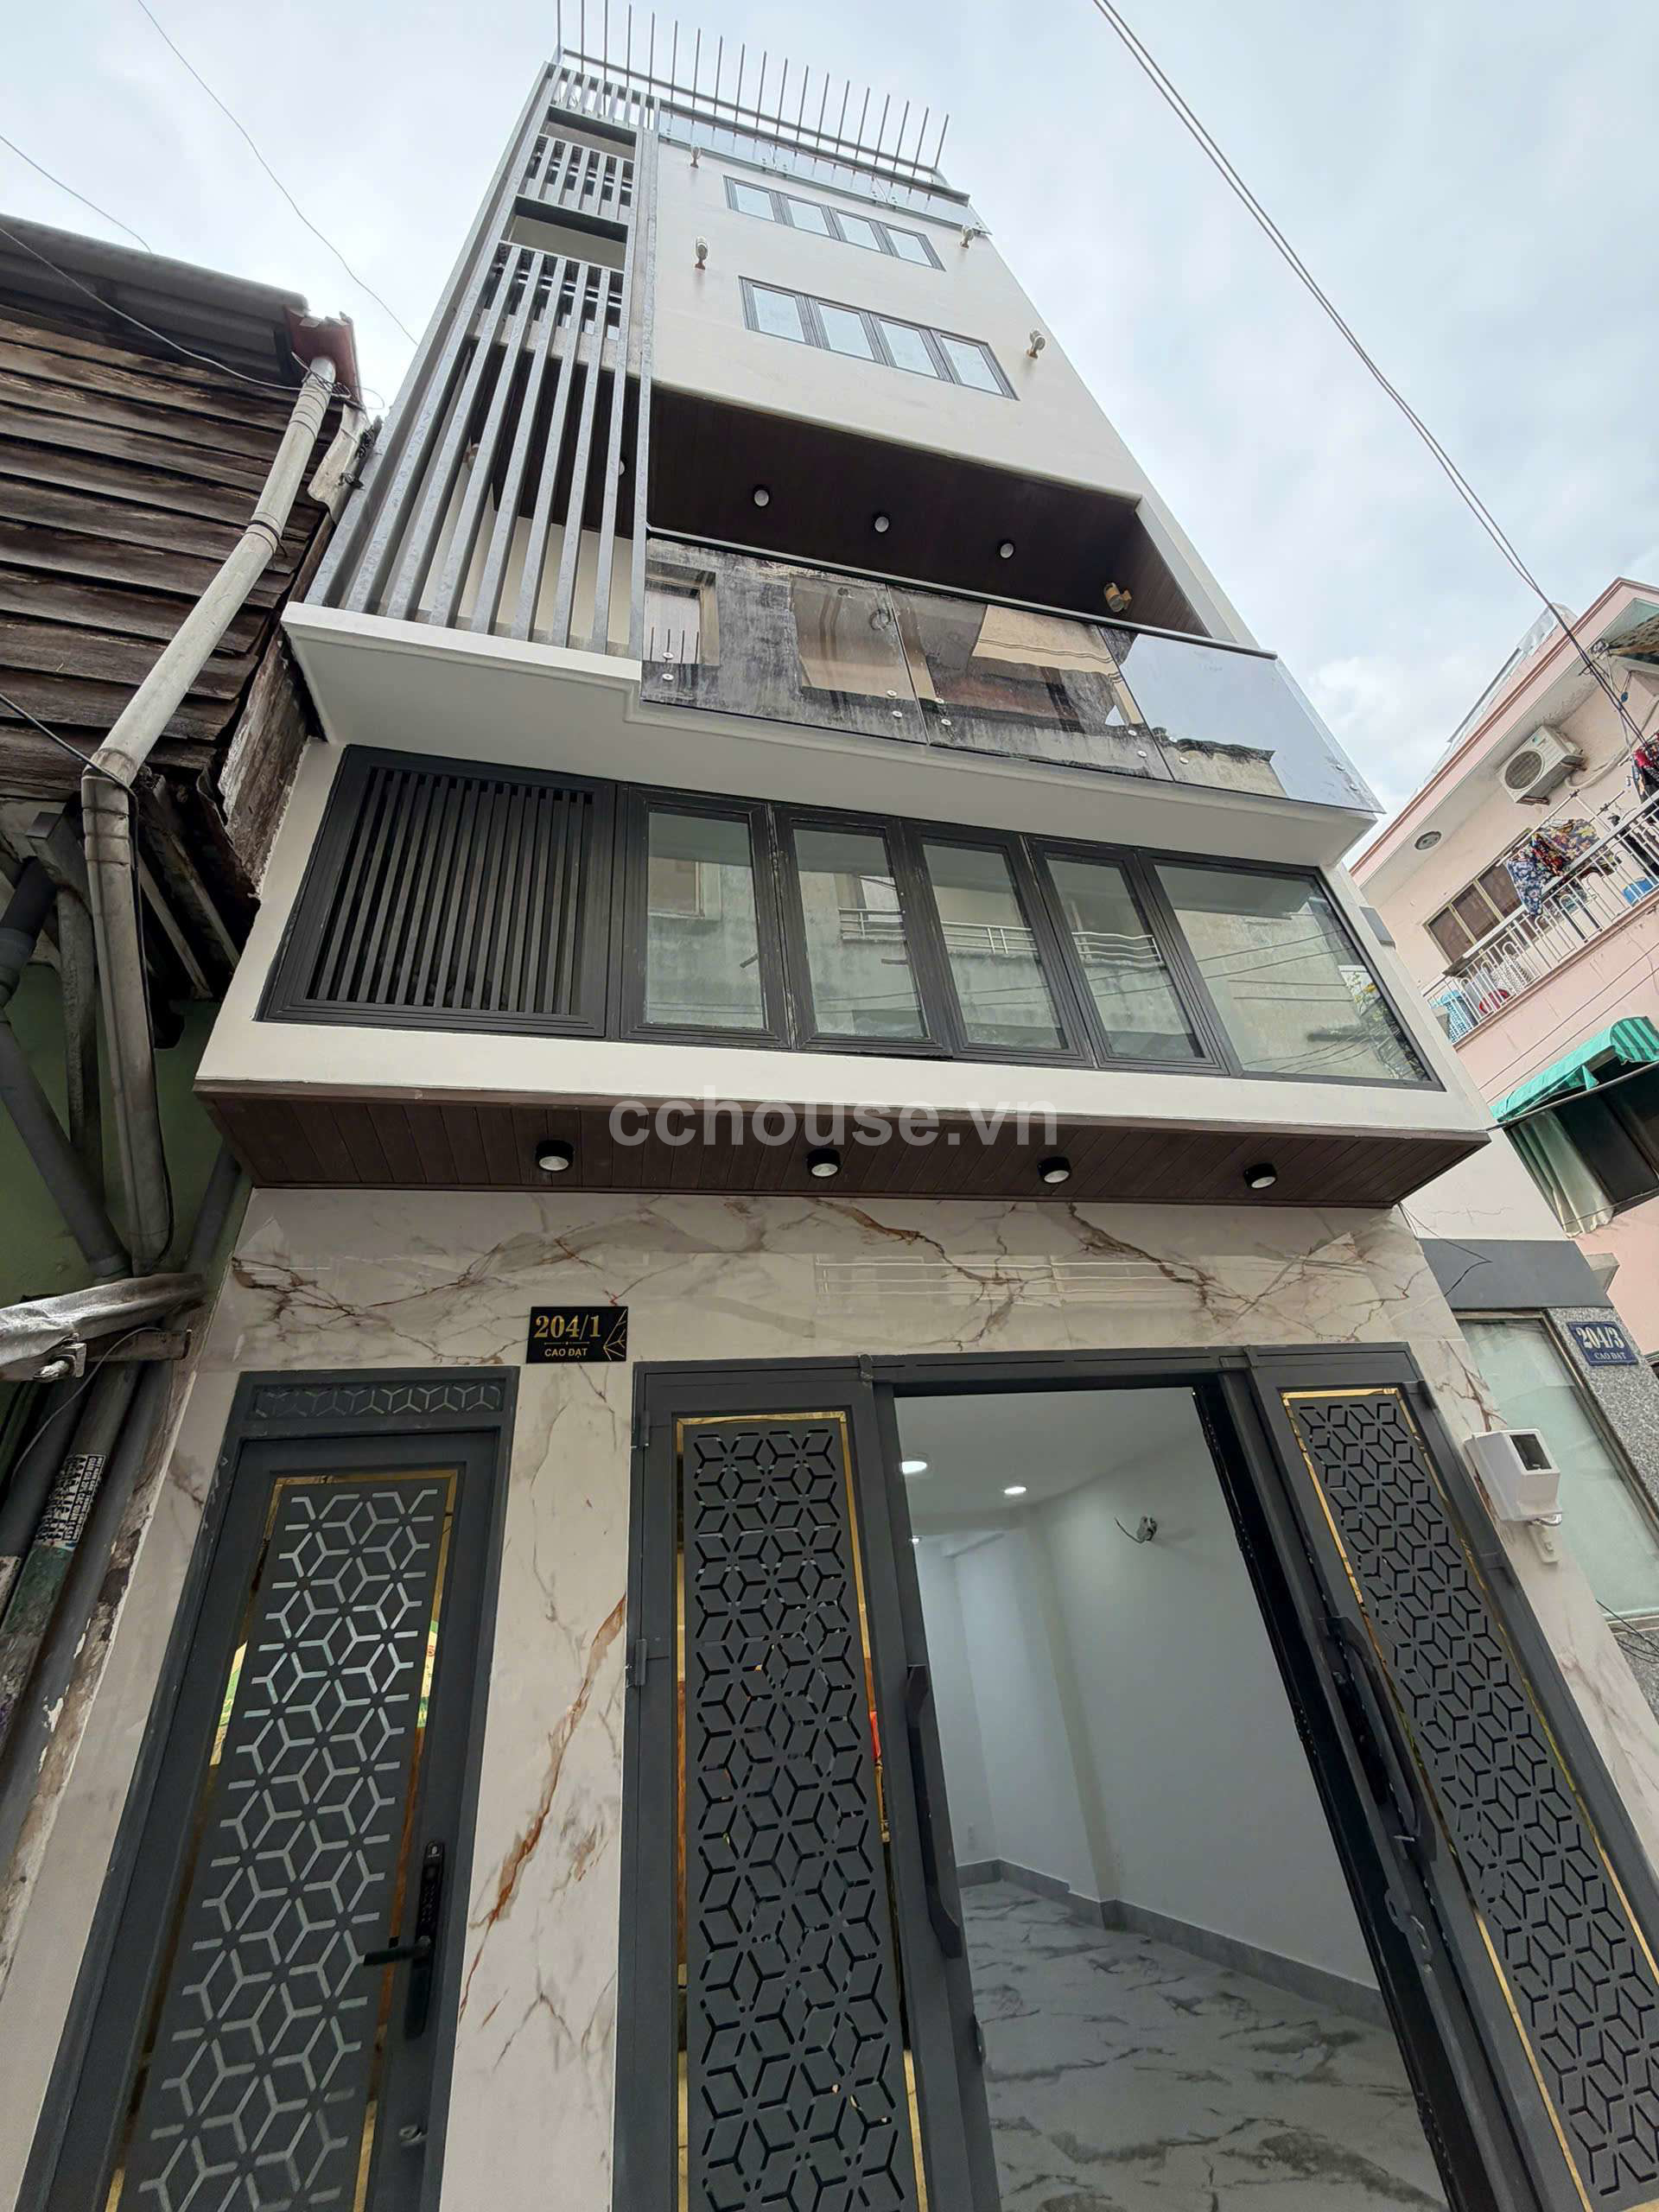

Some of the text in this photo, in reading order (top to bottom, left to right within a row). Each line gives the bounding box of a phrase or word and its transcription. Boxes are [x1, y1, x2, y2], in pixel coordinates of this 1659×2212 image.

[534, 1314, 601, 1339] 204/1
[1575, 1326, 1624, 1349] 204/3
[544, 1348, 566, 1357] CAO
